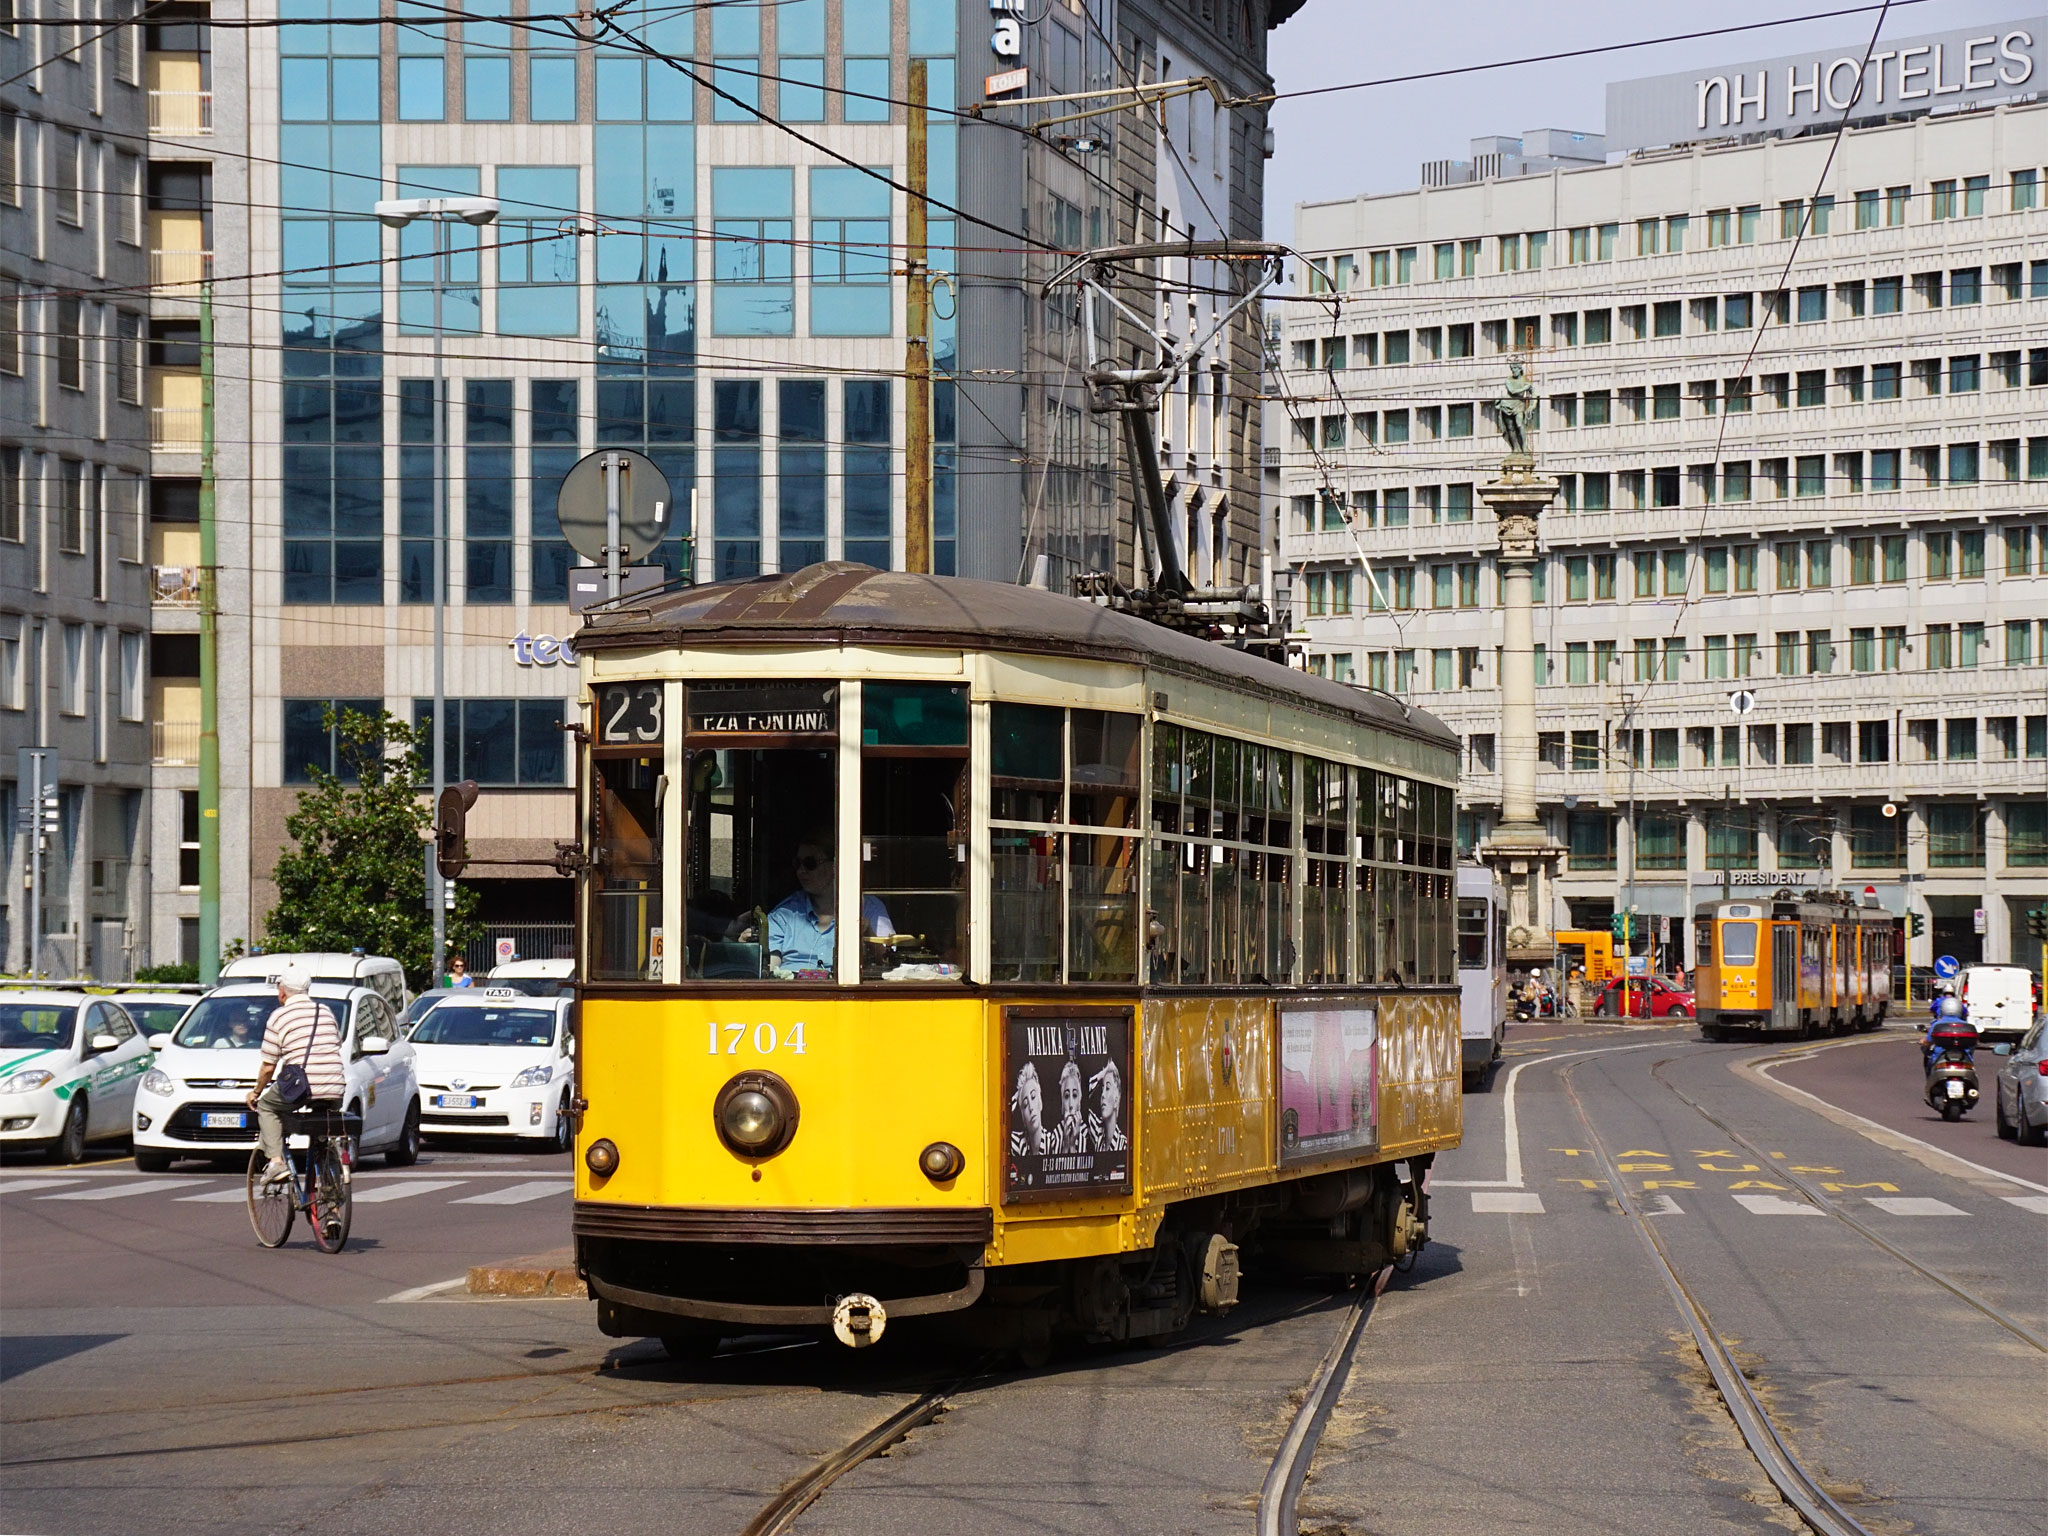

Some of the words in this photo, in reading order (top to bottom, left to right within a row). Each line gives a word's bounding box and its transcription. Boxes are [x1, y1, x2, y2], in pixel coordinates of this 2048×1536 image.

[990, 69, 1025, 92] TOUR
[1787, 30, 2033, 116] HOTELES
[604, 685, 662, 741] 23
[747, 711, 829, 730] FONTANA
[1733, 872, 1806, 885] PRESIDENT
[486, 989, 512, 997] TAXI
[708, 1022, 808, 1055] 1704
[1027, 1026, 1064, 1056] MALIKA
[1080, 1026, 1107, 1055] AYANE
[1217, 1126, 1235, 1155] 1704
[1556, 1178, 1901, 1193] TRAM
